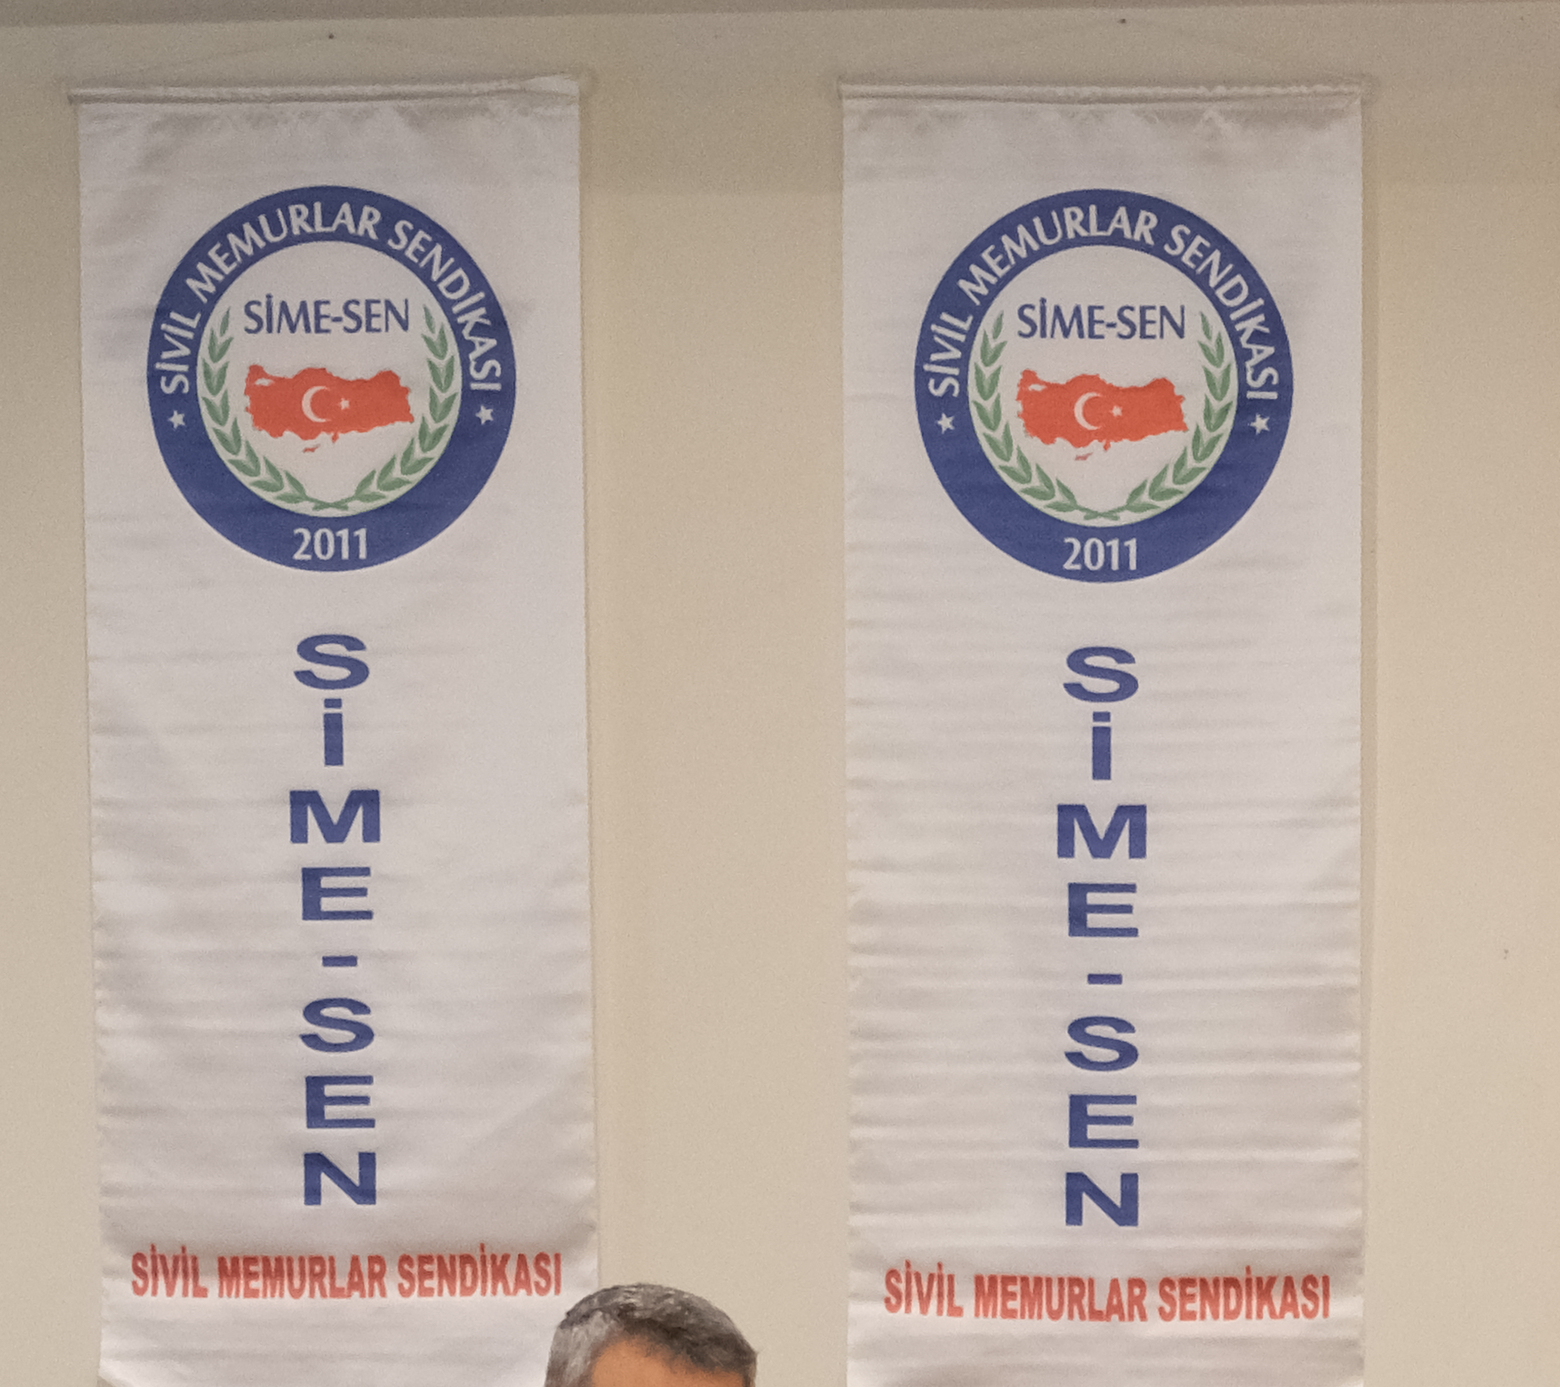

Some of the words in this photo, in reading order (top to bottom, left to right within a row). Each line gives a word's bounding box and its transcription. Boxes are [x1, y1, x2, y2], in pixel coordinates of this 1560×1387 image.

[155, 312, 202, 395] SİVİL
[185, 201, 382, 303] MEMURLAR
[387, 220, 503, 392] SENDİKASI
[244, 293, 409, 334] SİME-SEN
[924, 312, 974, 397] SİVİL
[958, 204, 1159, 305] MEMURLAR
[1164, 224, 1280, 400] SENDİKASI
[1017, 297, 1186, 340] SİME-SEN
[293, 528, 367, 560] 2011
[1063, 538, 1138, 570] 2011
[291, 634, 381, 1206] SİME-SEN
[1058, 646, 1147, 1227] SİME-SEN
[131, 1244, 211, 1299] SİVİL
[217, 1255, 389, 1300] MEMURLAR
[397, 1244, 563, 1299] SENDİKASI
[884, 1260, 966, 1319] SİVİL
[974, 1275, 1150, 1323] MEMURLAR
[1157, 1266, 1332, 1323] SENDİKASI
